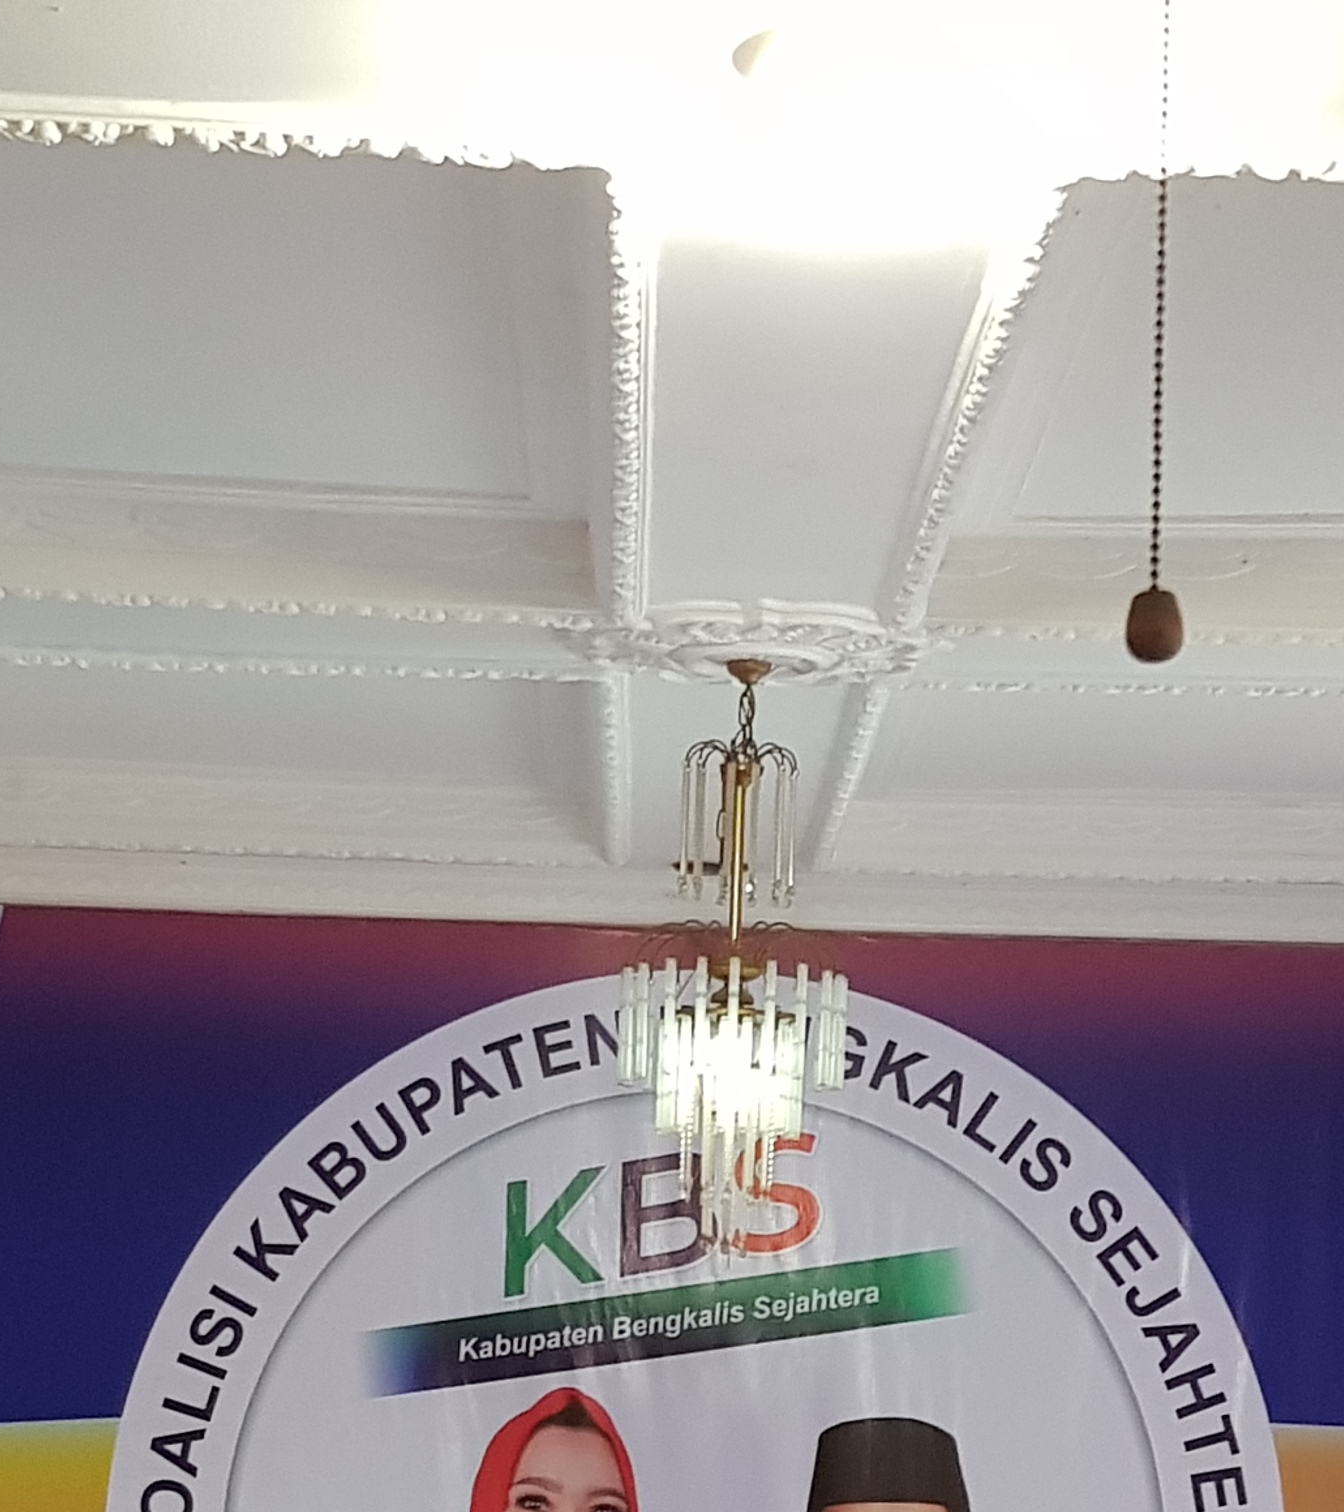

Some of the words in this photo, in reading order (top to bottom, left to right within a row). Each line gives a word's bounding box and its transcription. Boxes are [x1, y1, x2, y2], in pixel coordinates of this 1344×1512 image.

[232, 1013, 619, 1283] KABUPATEN
[504, 1133, 821, 1298] KBS
[458, 1323, 604, 1362] Kabupaten
[612, 1300, 745, 1341] Bengkalis
[752, 1282, 880, 1321] Sejahtera
